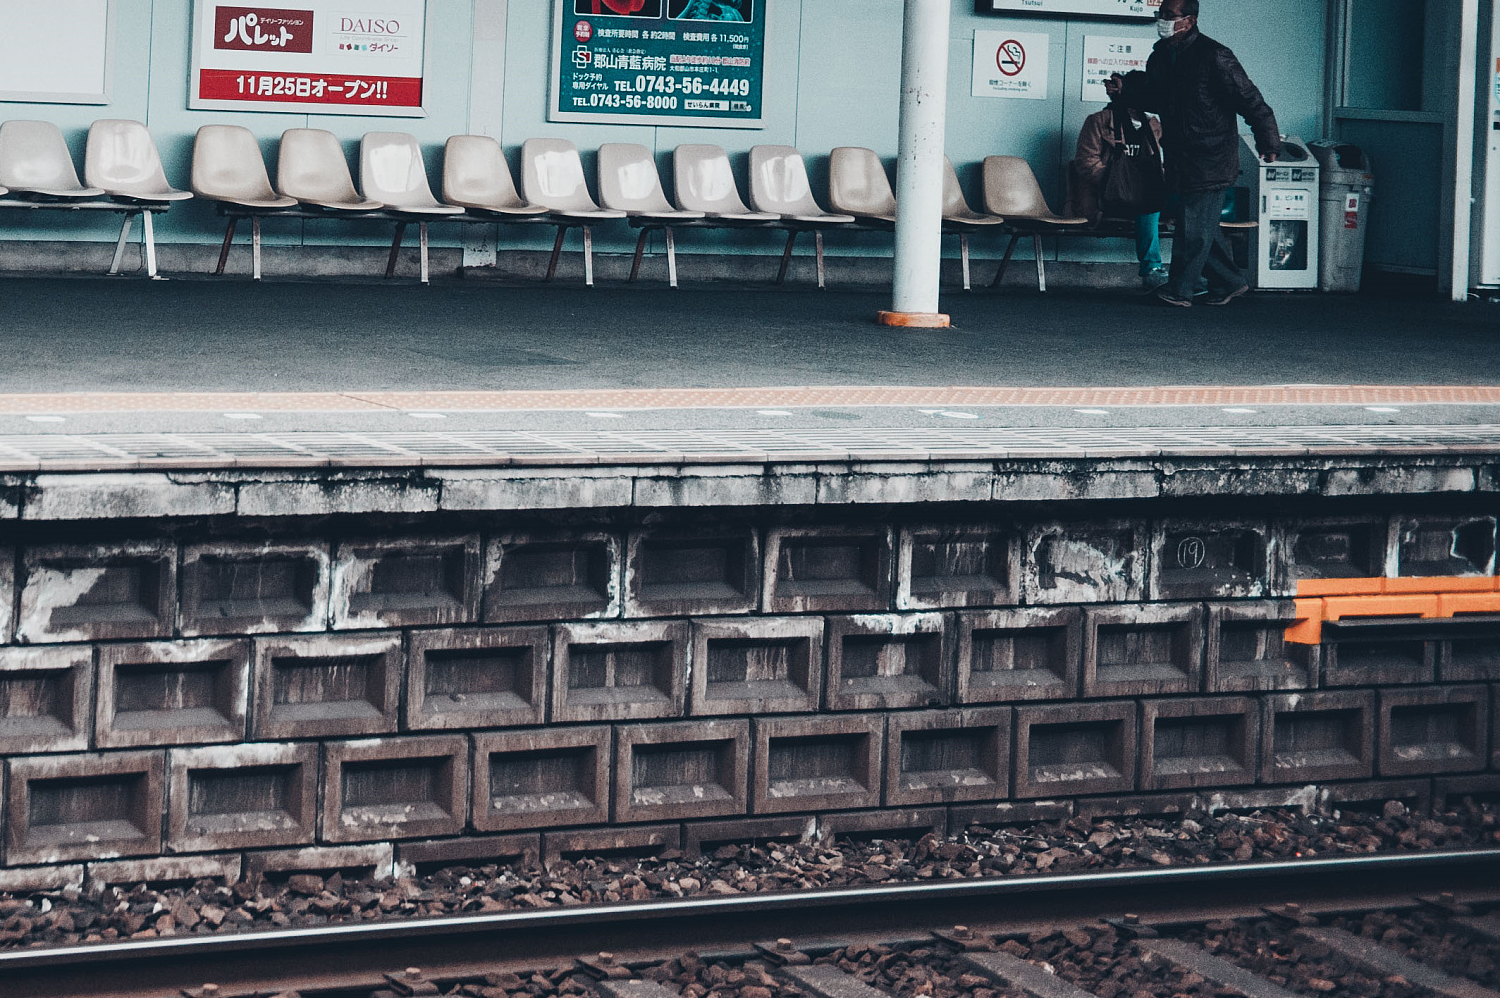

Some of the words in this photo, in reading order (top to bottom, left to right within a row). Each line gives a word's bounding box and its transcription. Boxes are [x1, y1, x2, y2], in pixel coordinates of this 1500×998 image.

[1129, 5, 1144, 14] Kujo
[224, 12, 294, 47] パレット
[340, 17, 400, 34] DAISO
[597, 28, 639, 39] 検査所要時間
[650, 30, 675, 40] 約2時間
[683, 32, 709, 41] 検査費用
[369, 42, 399, 53] ダイソー
[1109, 44, 1132, 53] ご注意
[593, 54, 667, 71] 郡山青藍病院
[1087, 57, 1147, 67] 線路への立入りは危険で
[572, 72, 603, 81] ドック予約
[572, 81, 609, 91] 専用ダイヤル
[614, 74, 750, 96] TEL.0743-56-4449
[572, 94, 678, 110] TEL.0743-56-8000
